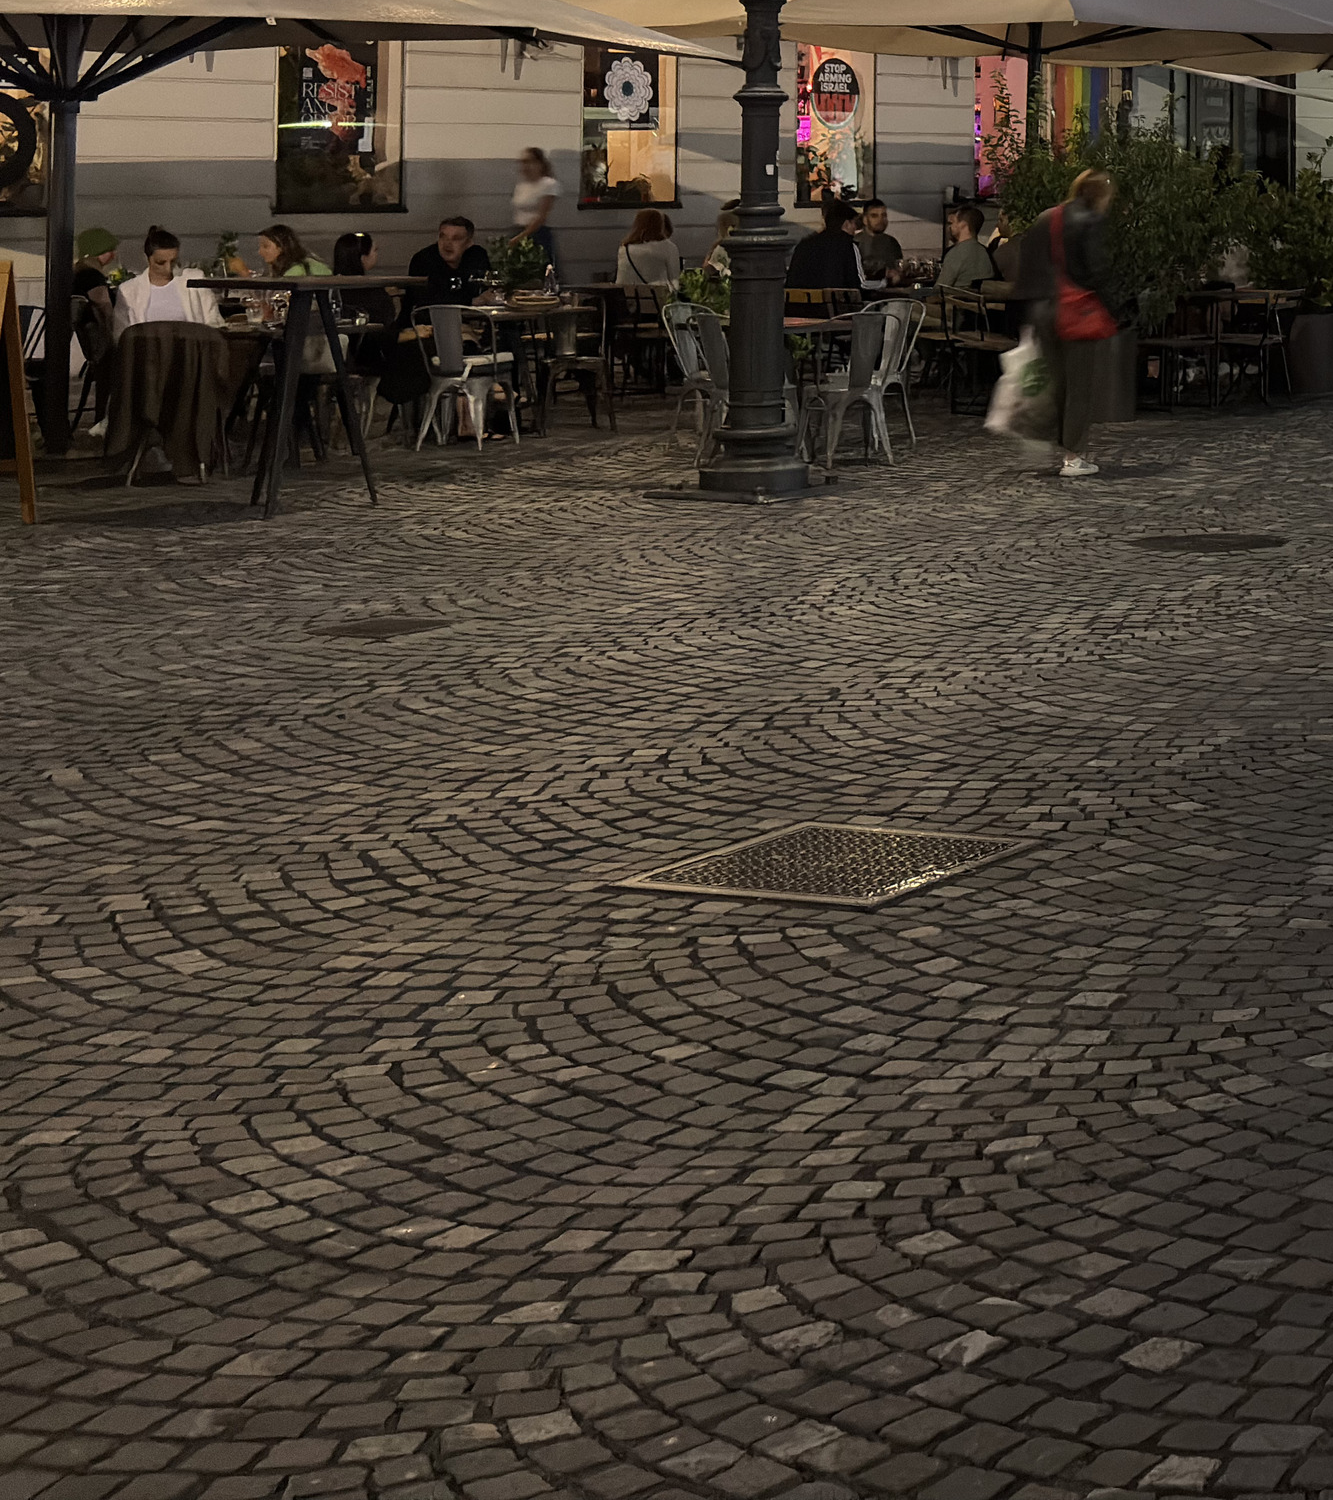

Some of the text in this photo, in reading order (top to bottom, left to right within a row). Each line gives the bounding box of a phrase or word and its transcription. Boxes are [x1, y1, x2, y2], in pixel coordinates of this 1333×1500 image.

[824, 64, 847, 73] STOP
[818, 73, 852, 83] ARMING
[820, 83, 850, 92] ISRAEL
